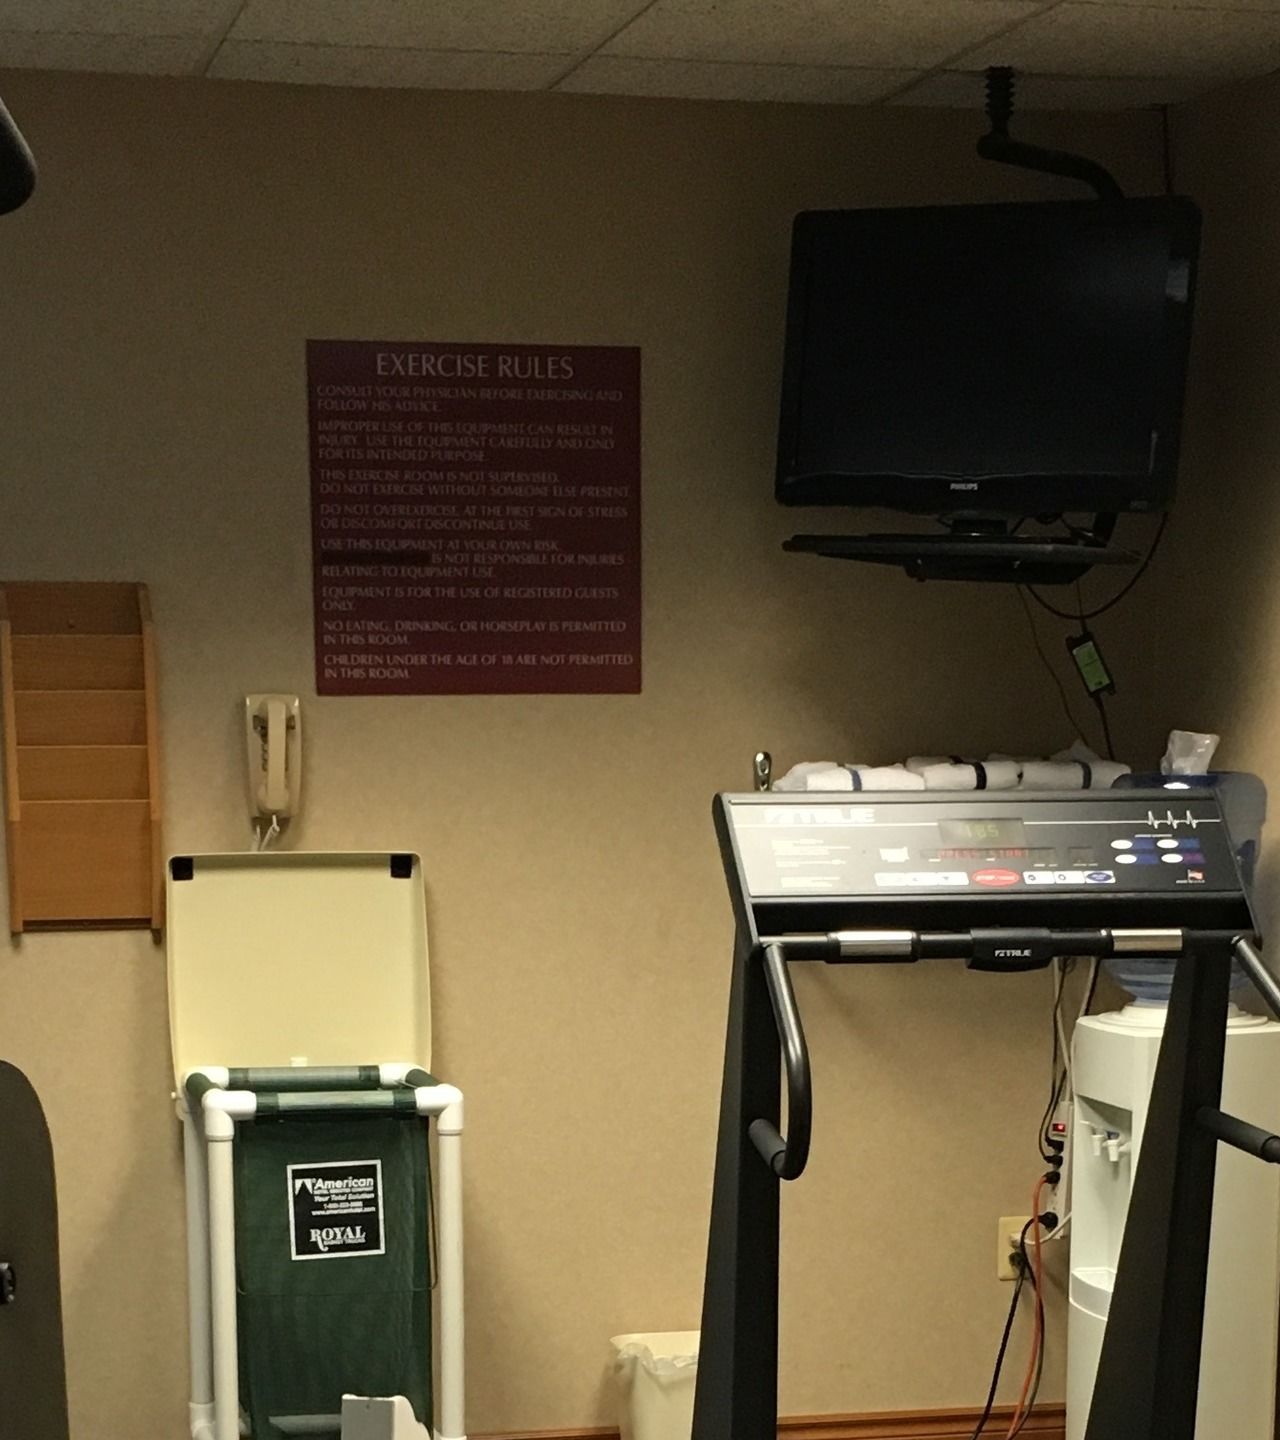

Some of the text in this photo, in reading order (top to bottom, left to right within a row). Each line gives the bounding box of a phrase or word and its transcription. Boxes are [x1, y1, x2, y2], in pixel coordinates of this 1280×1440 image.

[377, 353, 574, 380] EXERCISE RULES
[323, 654, 383, 665] CHILDREN
[314, 1177, 374, 1189] American
[310, 1226, 366, 1251] ROYAL
